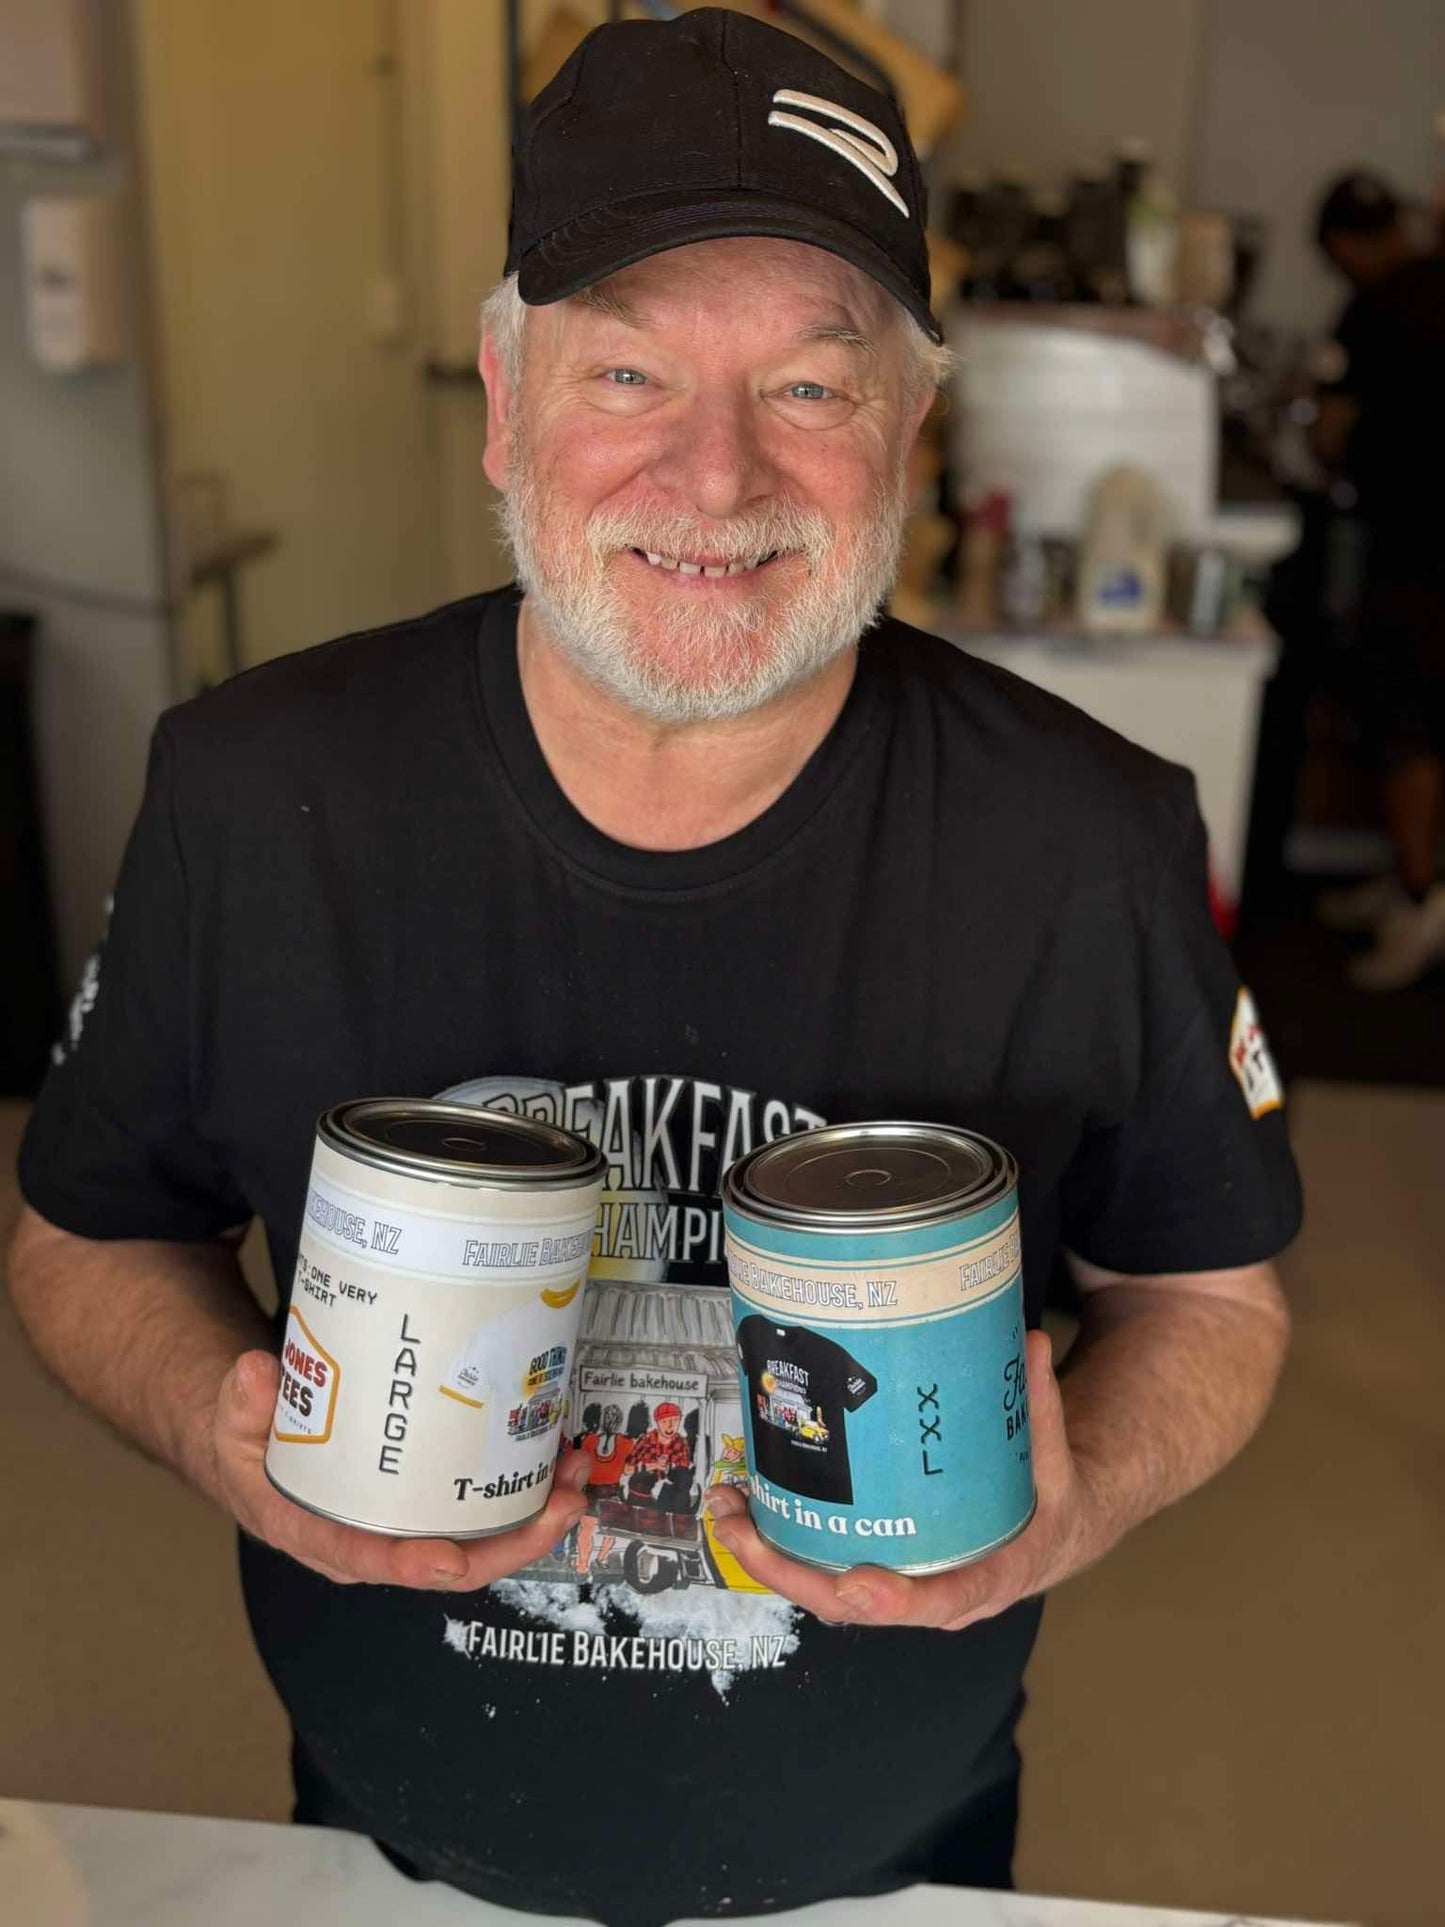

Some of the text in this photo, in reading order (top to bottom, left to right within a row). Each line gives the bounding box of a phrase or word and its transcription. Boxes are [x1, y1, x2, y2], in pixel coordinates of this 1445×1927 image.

[484, 1077, 827, 1191] EAKFA
[371, 1220, 402, 1254] NZ
[462, 1240, 539, 1267] FAIRLIE
[591, 1202, 721, 1262] HAMPI
[750, 1262, 864, 1310] BAKEHOUSE,
[867, 1280, 898, 1308] NZ
[958, 1241, 1010, 1291] FAIRLIE
[339, 1281, 378, 1305] VERY
[379, 1313, 421, 1475] LARGE
[584, 1371, 625, 1387] Fairlie
[630, 1373, 699, 1391] bakehouse
[917, 1383, 944, 1475] XXL
[454, 1470, 534, 1501] T-shirt
[535, 1462, 549, 1485] in
[794, 1499, 823, 1530] in
[828, 1515, 849, 1535] a
[854, 1516, 918, 1537] can
[468, 1620, 787, 1671] FAIRLIE BAKEHOUSE, NZ
